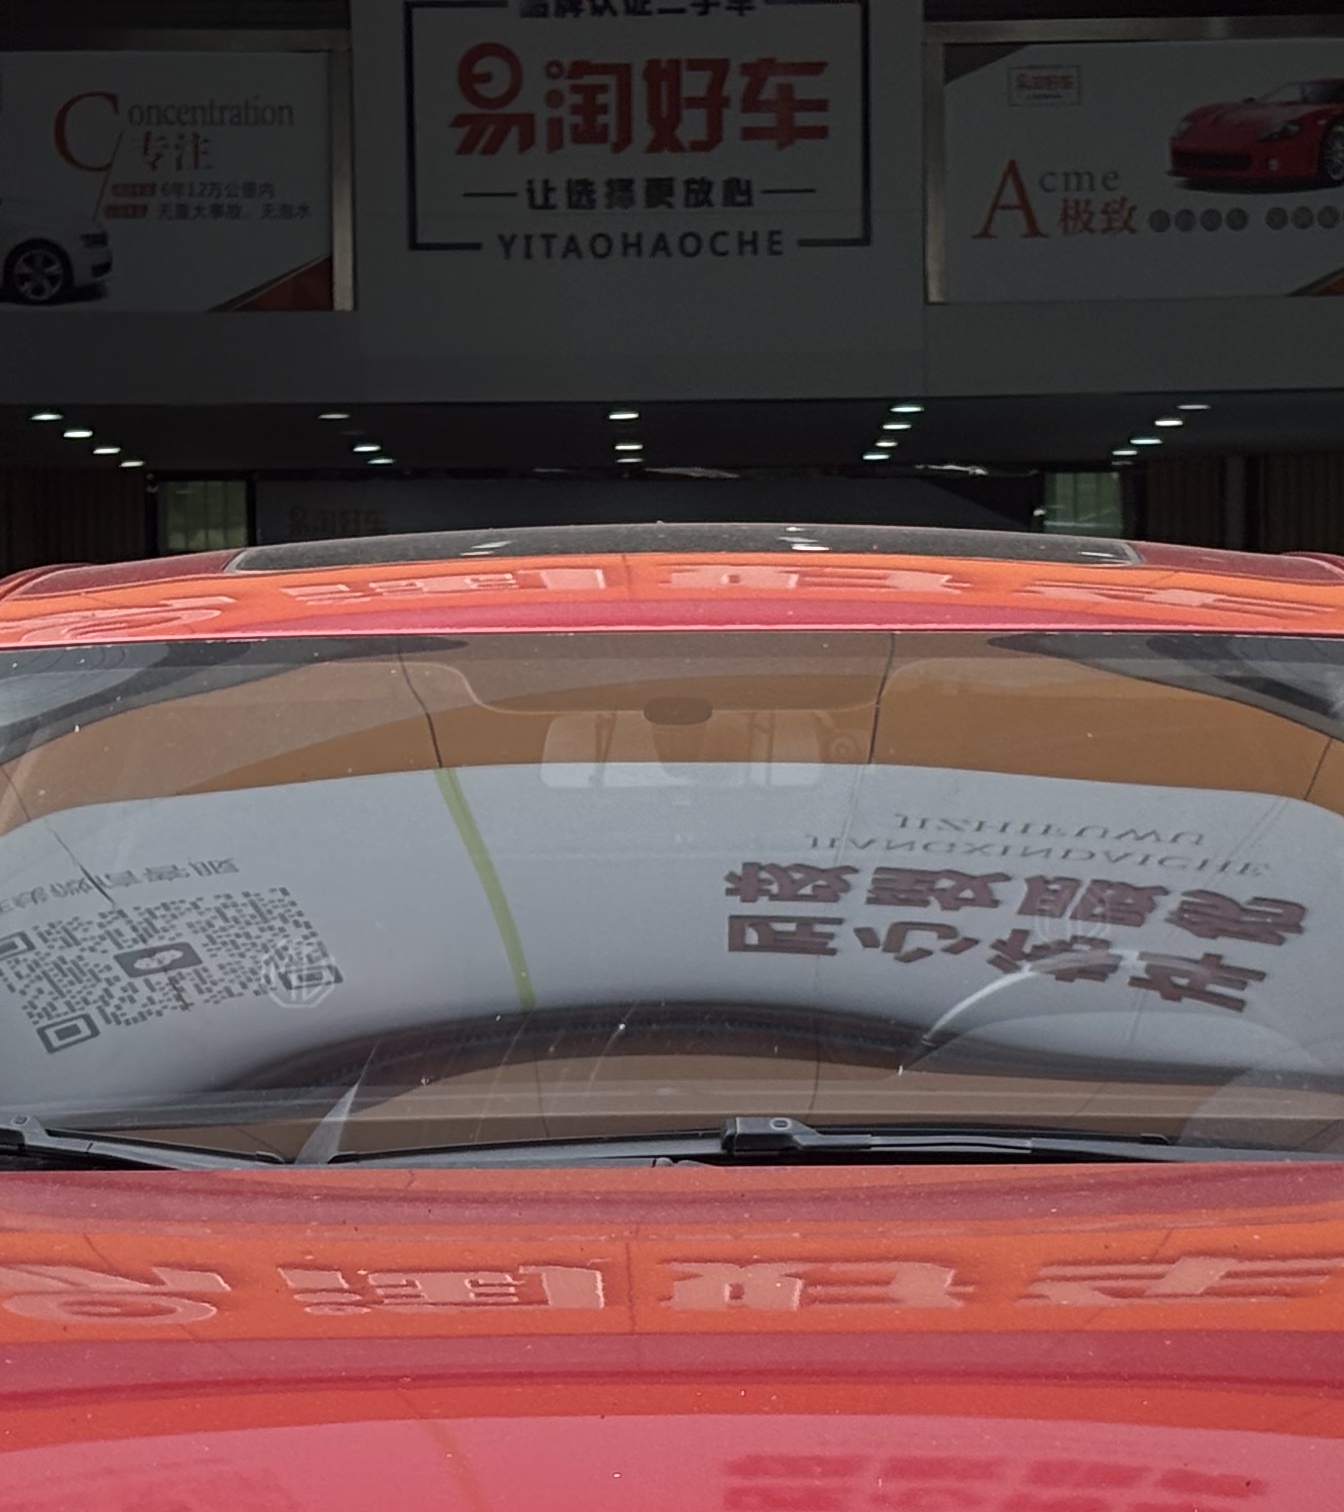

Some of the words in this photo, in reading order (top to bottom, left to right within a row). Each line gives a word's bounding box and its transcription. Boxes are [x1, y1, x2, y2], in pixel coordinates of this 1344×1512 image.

[449, 42, 830, 155] 易淘好车
[54, 92, 294, 172] Concentration
[139, 131, 213, 171] 专注
[526, 176, 755, 211] 让选择更放心
[971, 159, 1120, 239] Acme
[1058, 198, 1138, 236] 极致
[497, 230, 785, 260] YITAOHAOCHE
